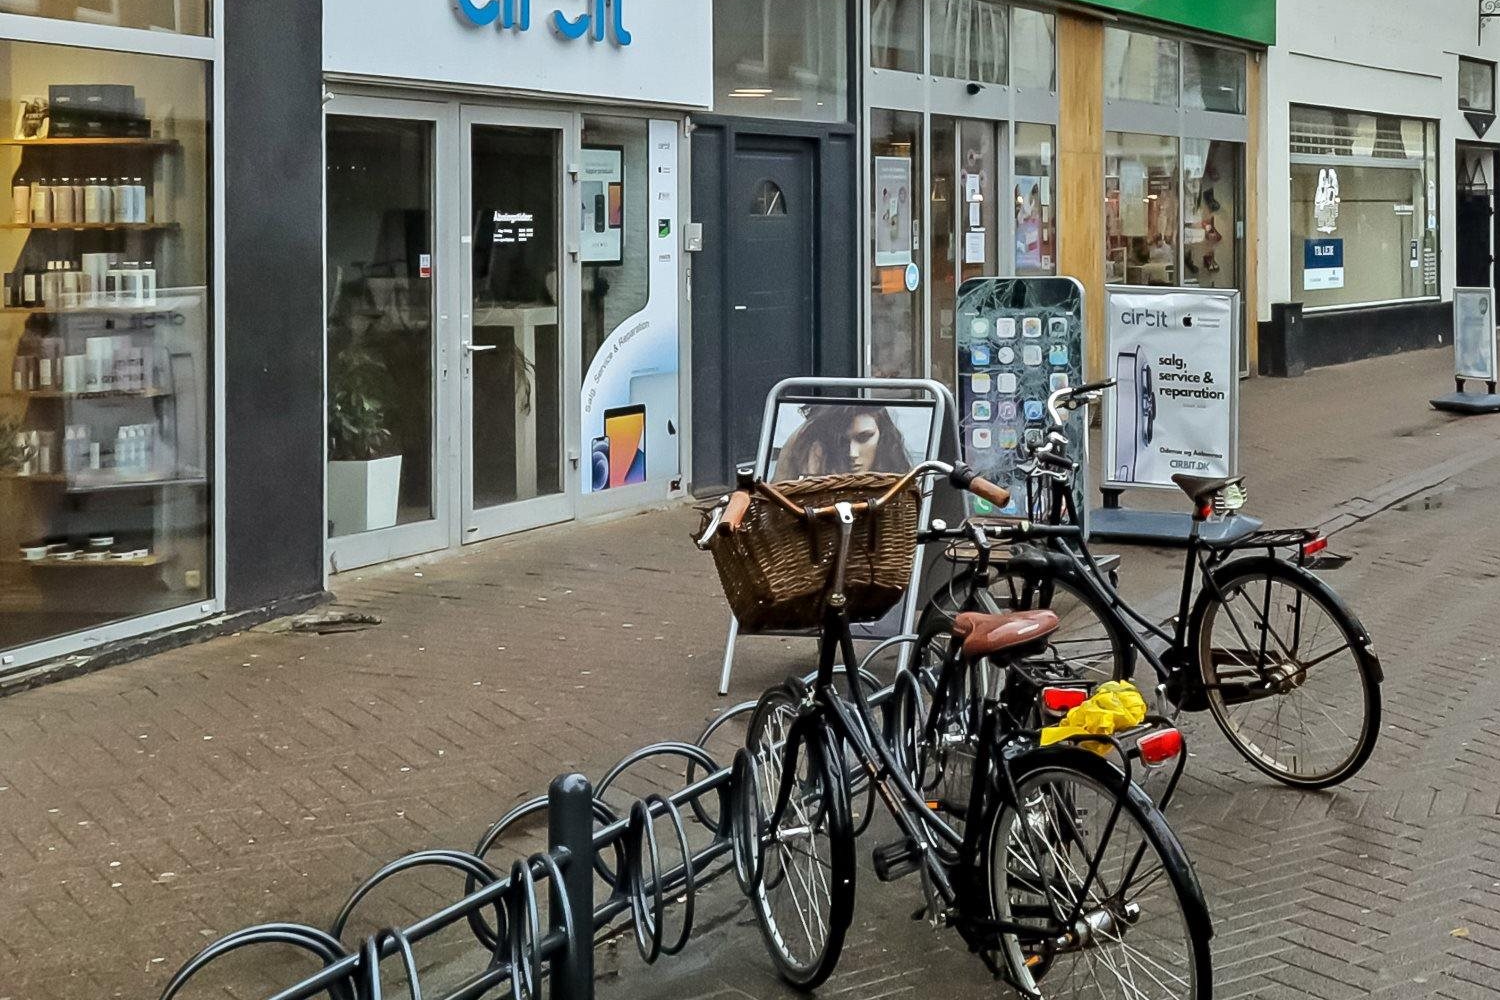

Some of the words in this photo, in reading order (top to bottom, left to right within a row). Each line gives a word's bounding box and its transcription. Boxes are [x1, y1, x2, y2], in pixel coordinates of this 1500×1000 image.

[1121, 309, 1168, 328] cirbit
[1158, 353, 1187, 370] salg,
[1158, 370, 1201, 383] service
[1203, 371, 1214, 384] &
[1159, 386, 1225, 400] reparation
